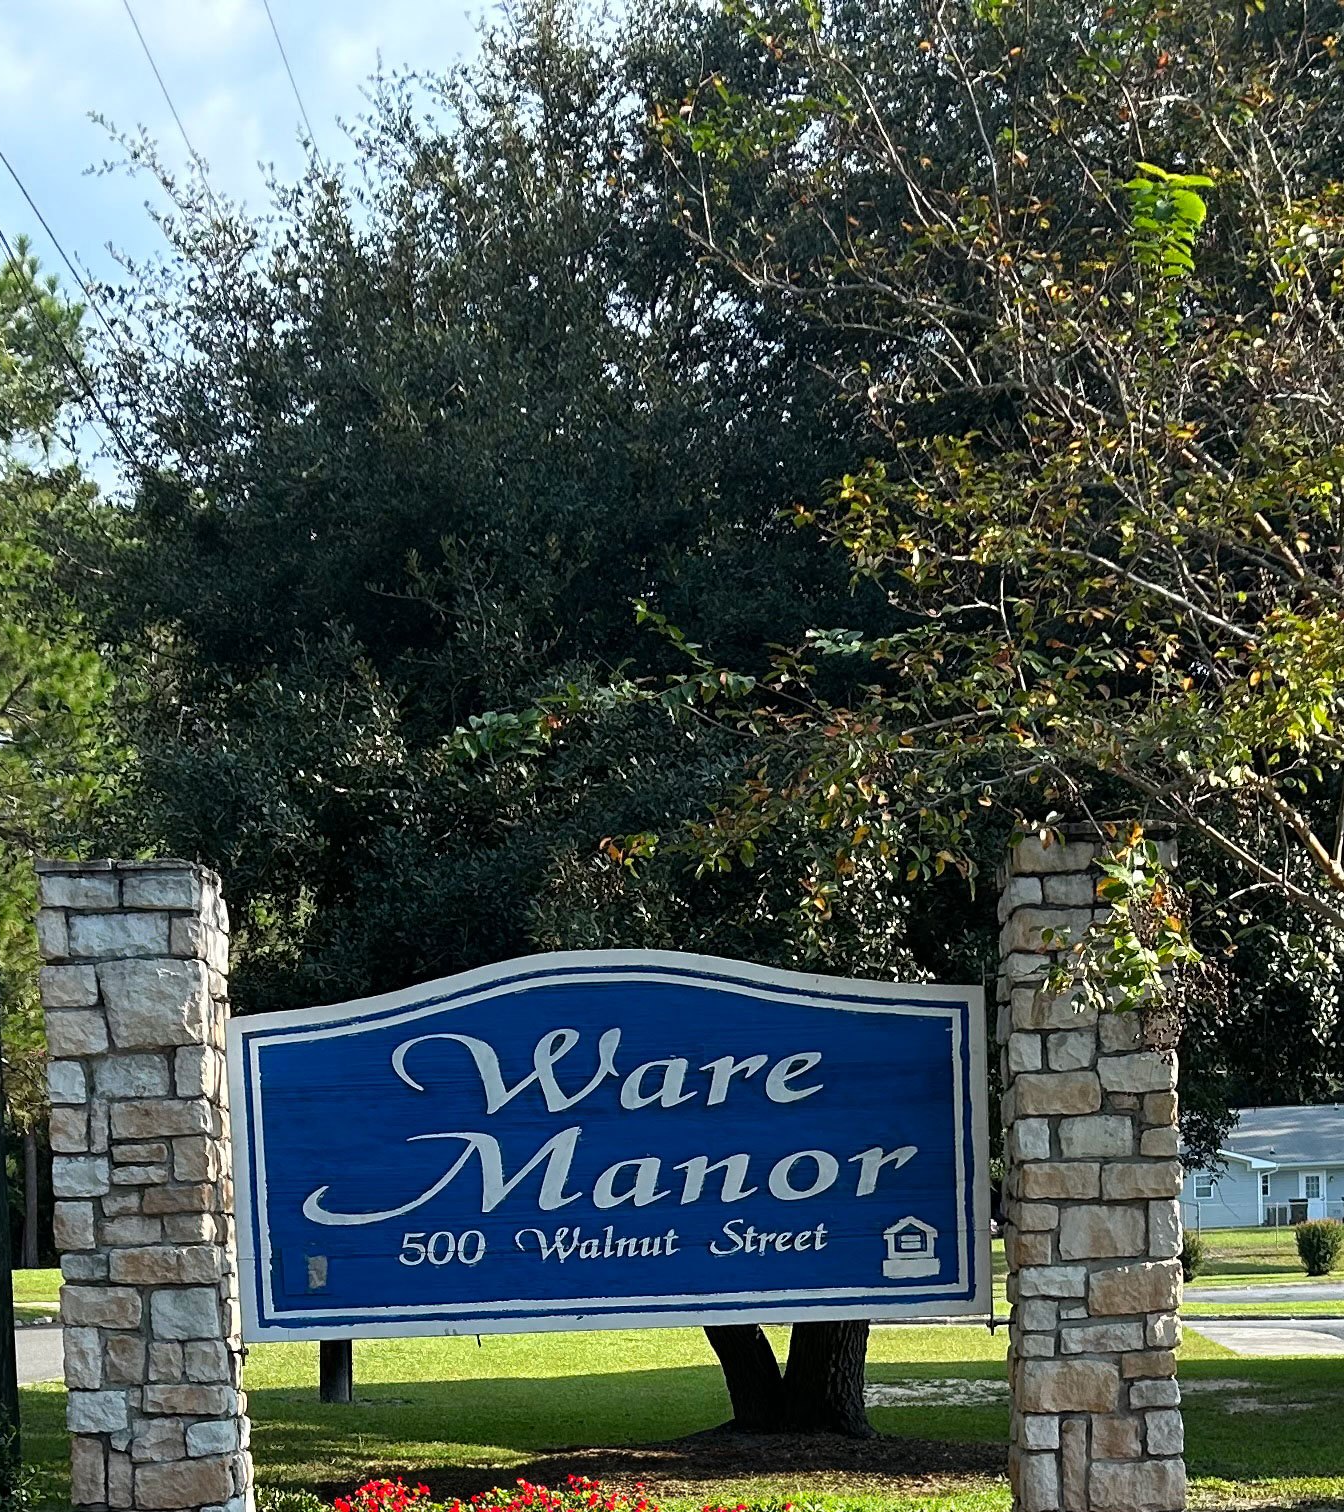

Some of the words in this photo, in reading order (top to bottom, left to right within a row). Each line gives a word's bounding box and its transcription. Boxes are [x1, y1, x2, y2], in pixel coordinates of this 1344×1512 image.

[392, 1028, 824, 1115] Ware
[303, 1127, 918, 1226] Manor
[398, 1230, 486, 1265] 500
[514, 1226, 679, 1263] Walnut
[709, 1219, 828, 1256] Street
